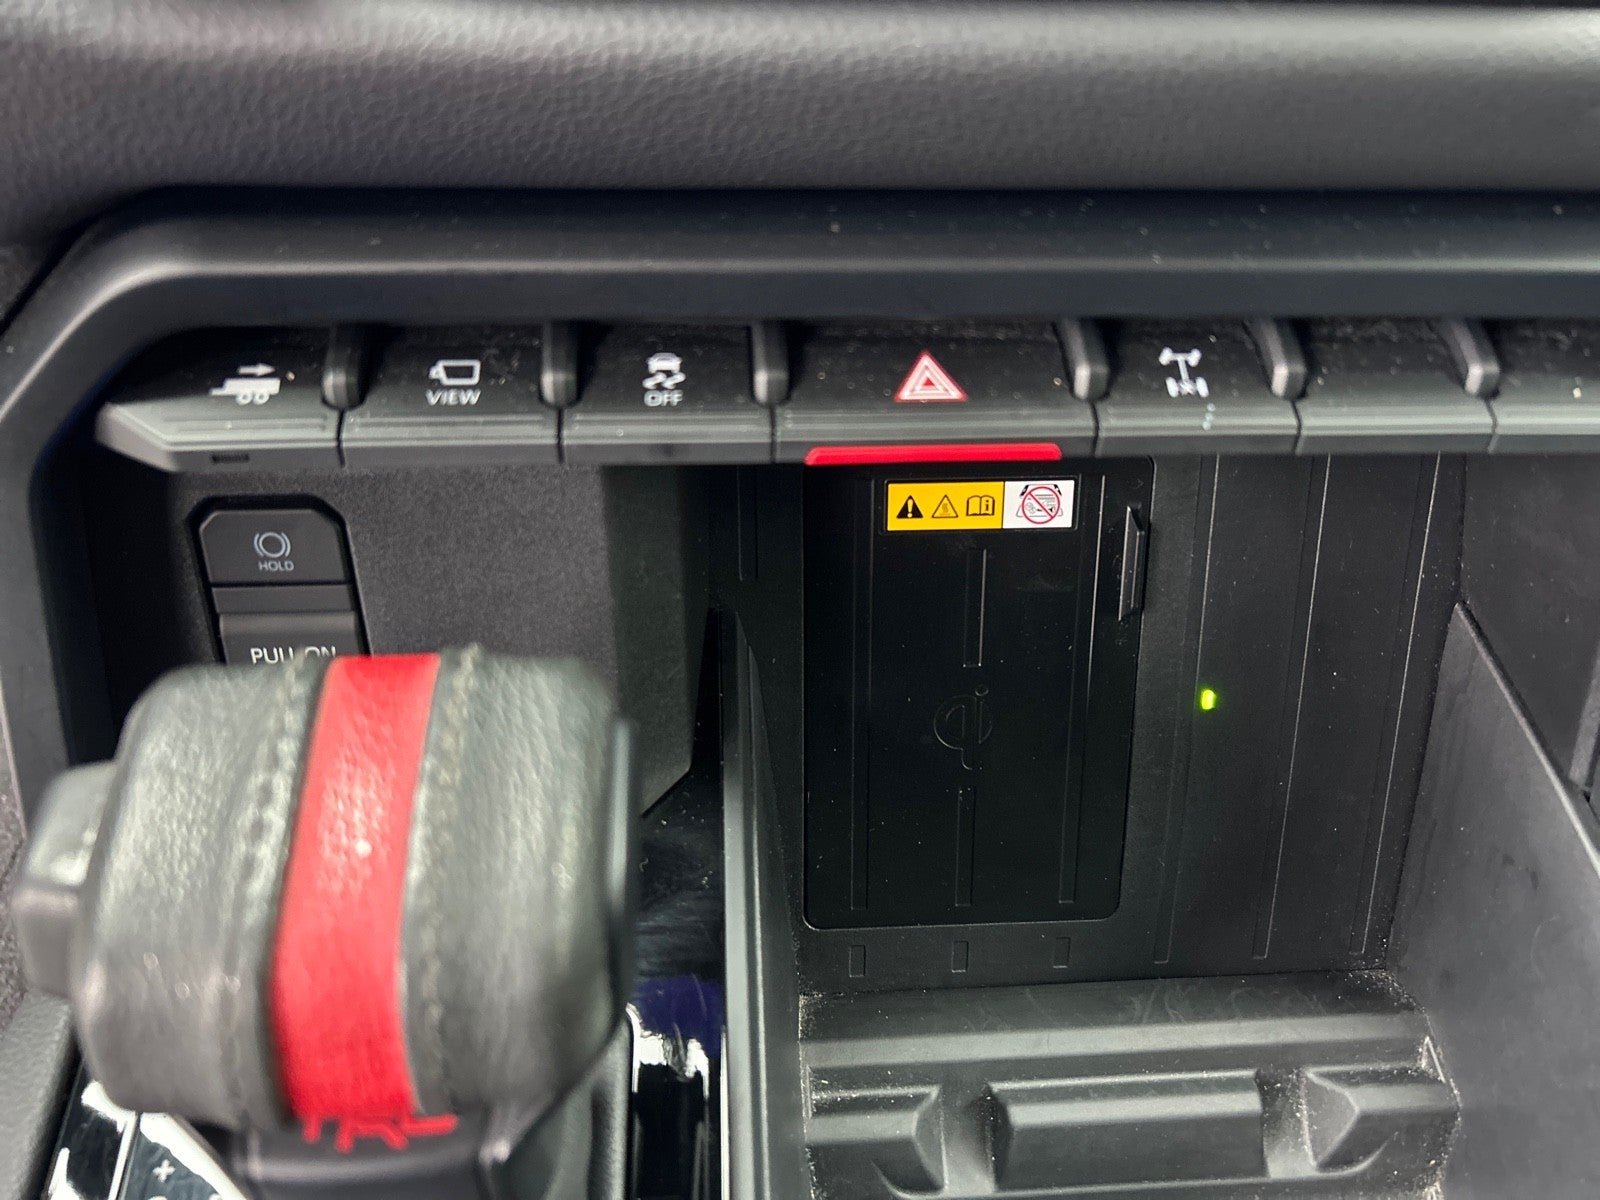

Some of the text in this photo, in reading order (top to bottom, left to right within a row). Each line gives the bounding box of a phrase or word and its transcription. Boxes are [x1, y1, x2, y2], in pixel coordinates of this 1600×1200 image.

[425, 388, 481, 406] VIEW
[643, 389, 684, 407] OFF
[258, 560, 295, 572] HOLD
